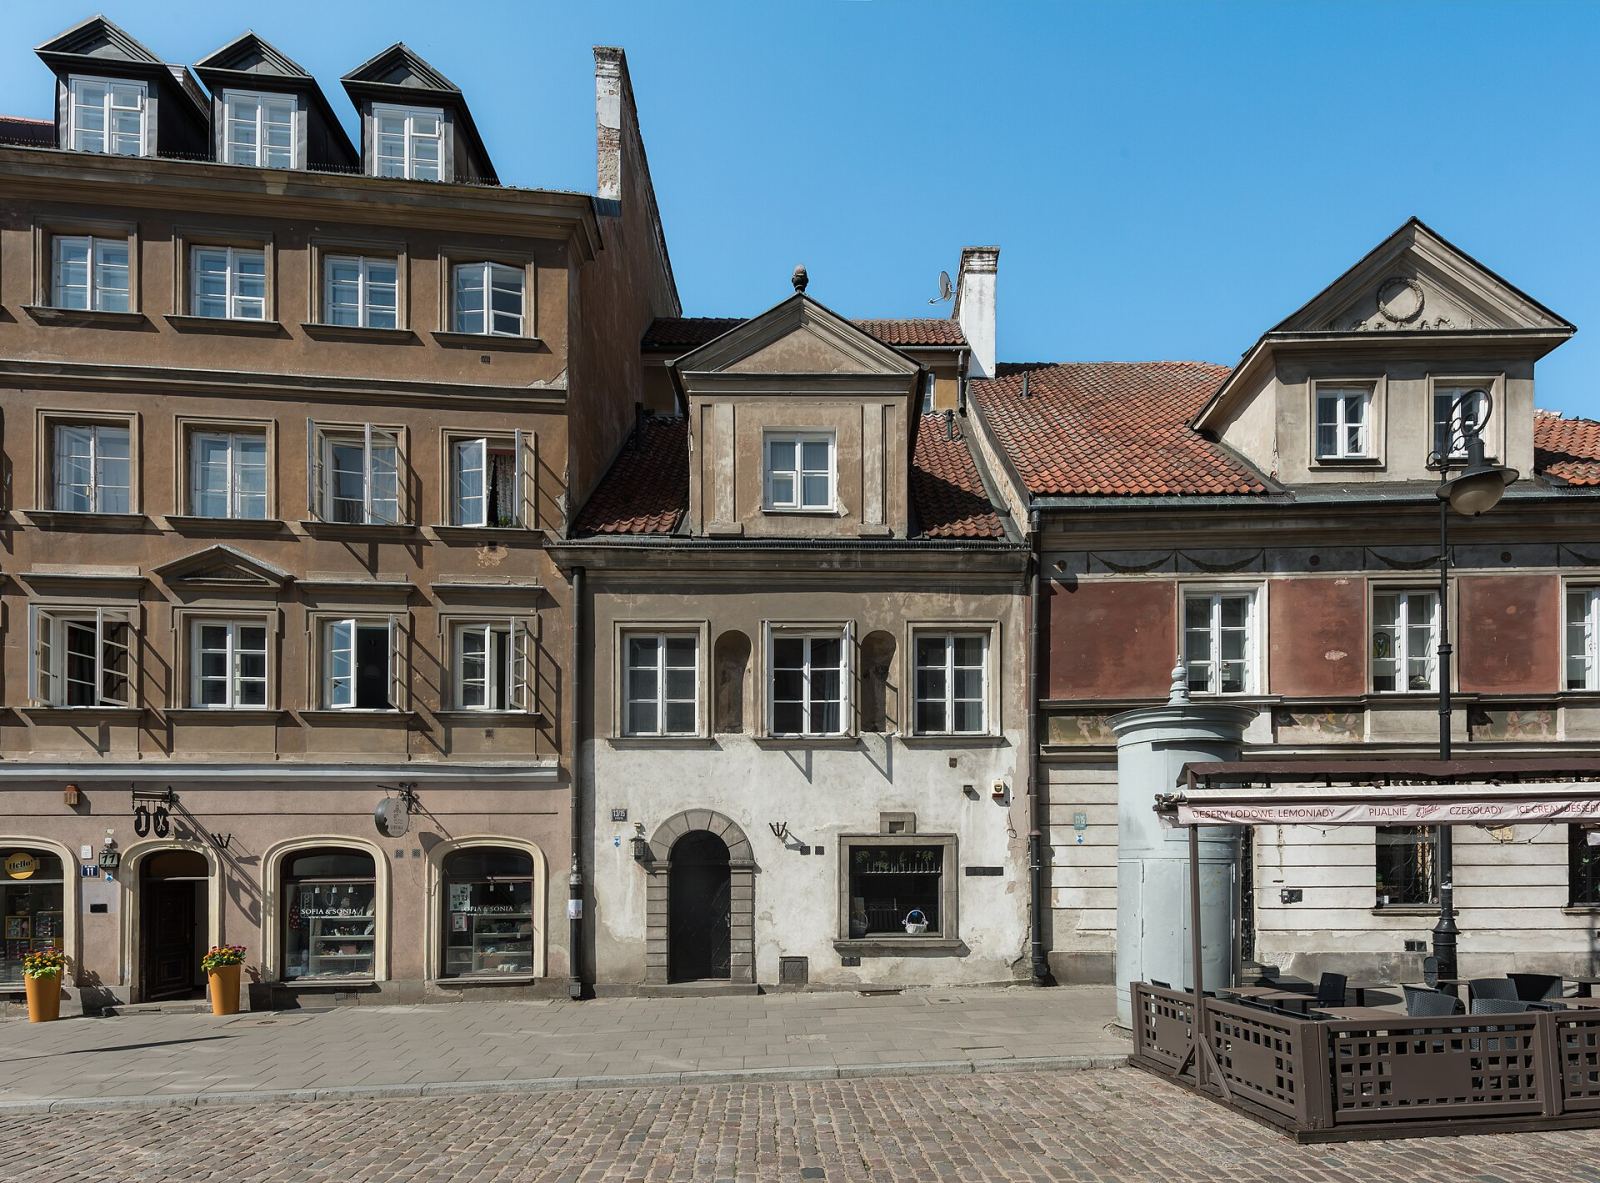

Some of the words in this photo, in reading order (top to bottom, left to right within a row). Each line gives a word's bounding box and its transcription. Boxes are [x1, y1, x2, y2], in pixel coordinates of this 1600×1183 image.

[1192, 810, 1228, 819] DESERY
[1278, 808, 1335, 817] LEMONIADY
[1369, 807, 1408, 816] PIJALNIE
[1517, 805, 1530, 814] ICE
[102, 854, 116, 864] 11
[86, 867, 94, 876] 11
